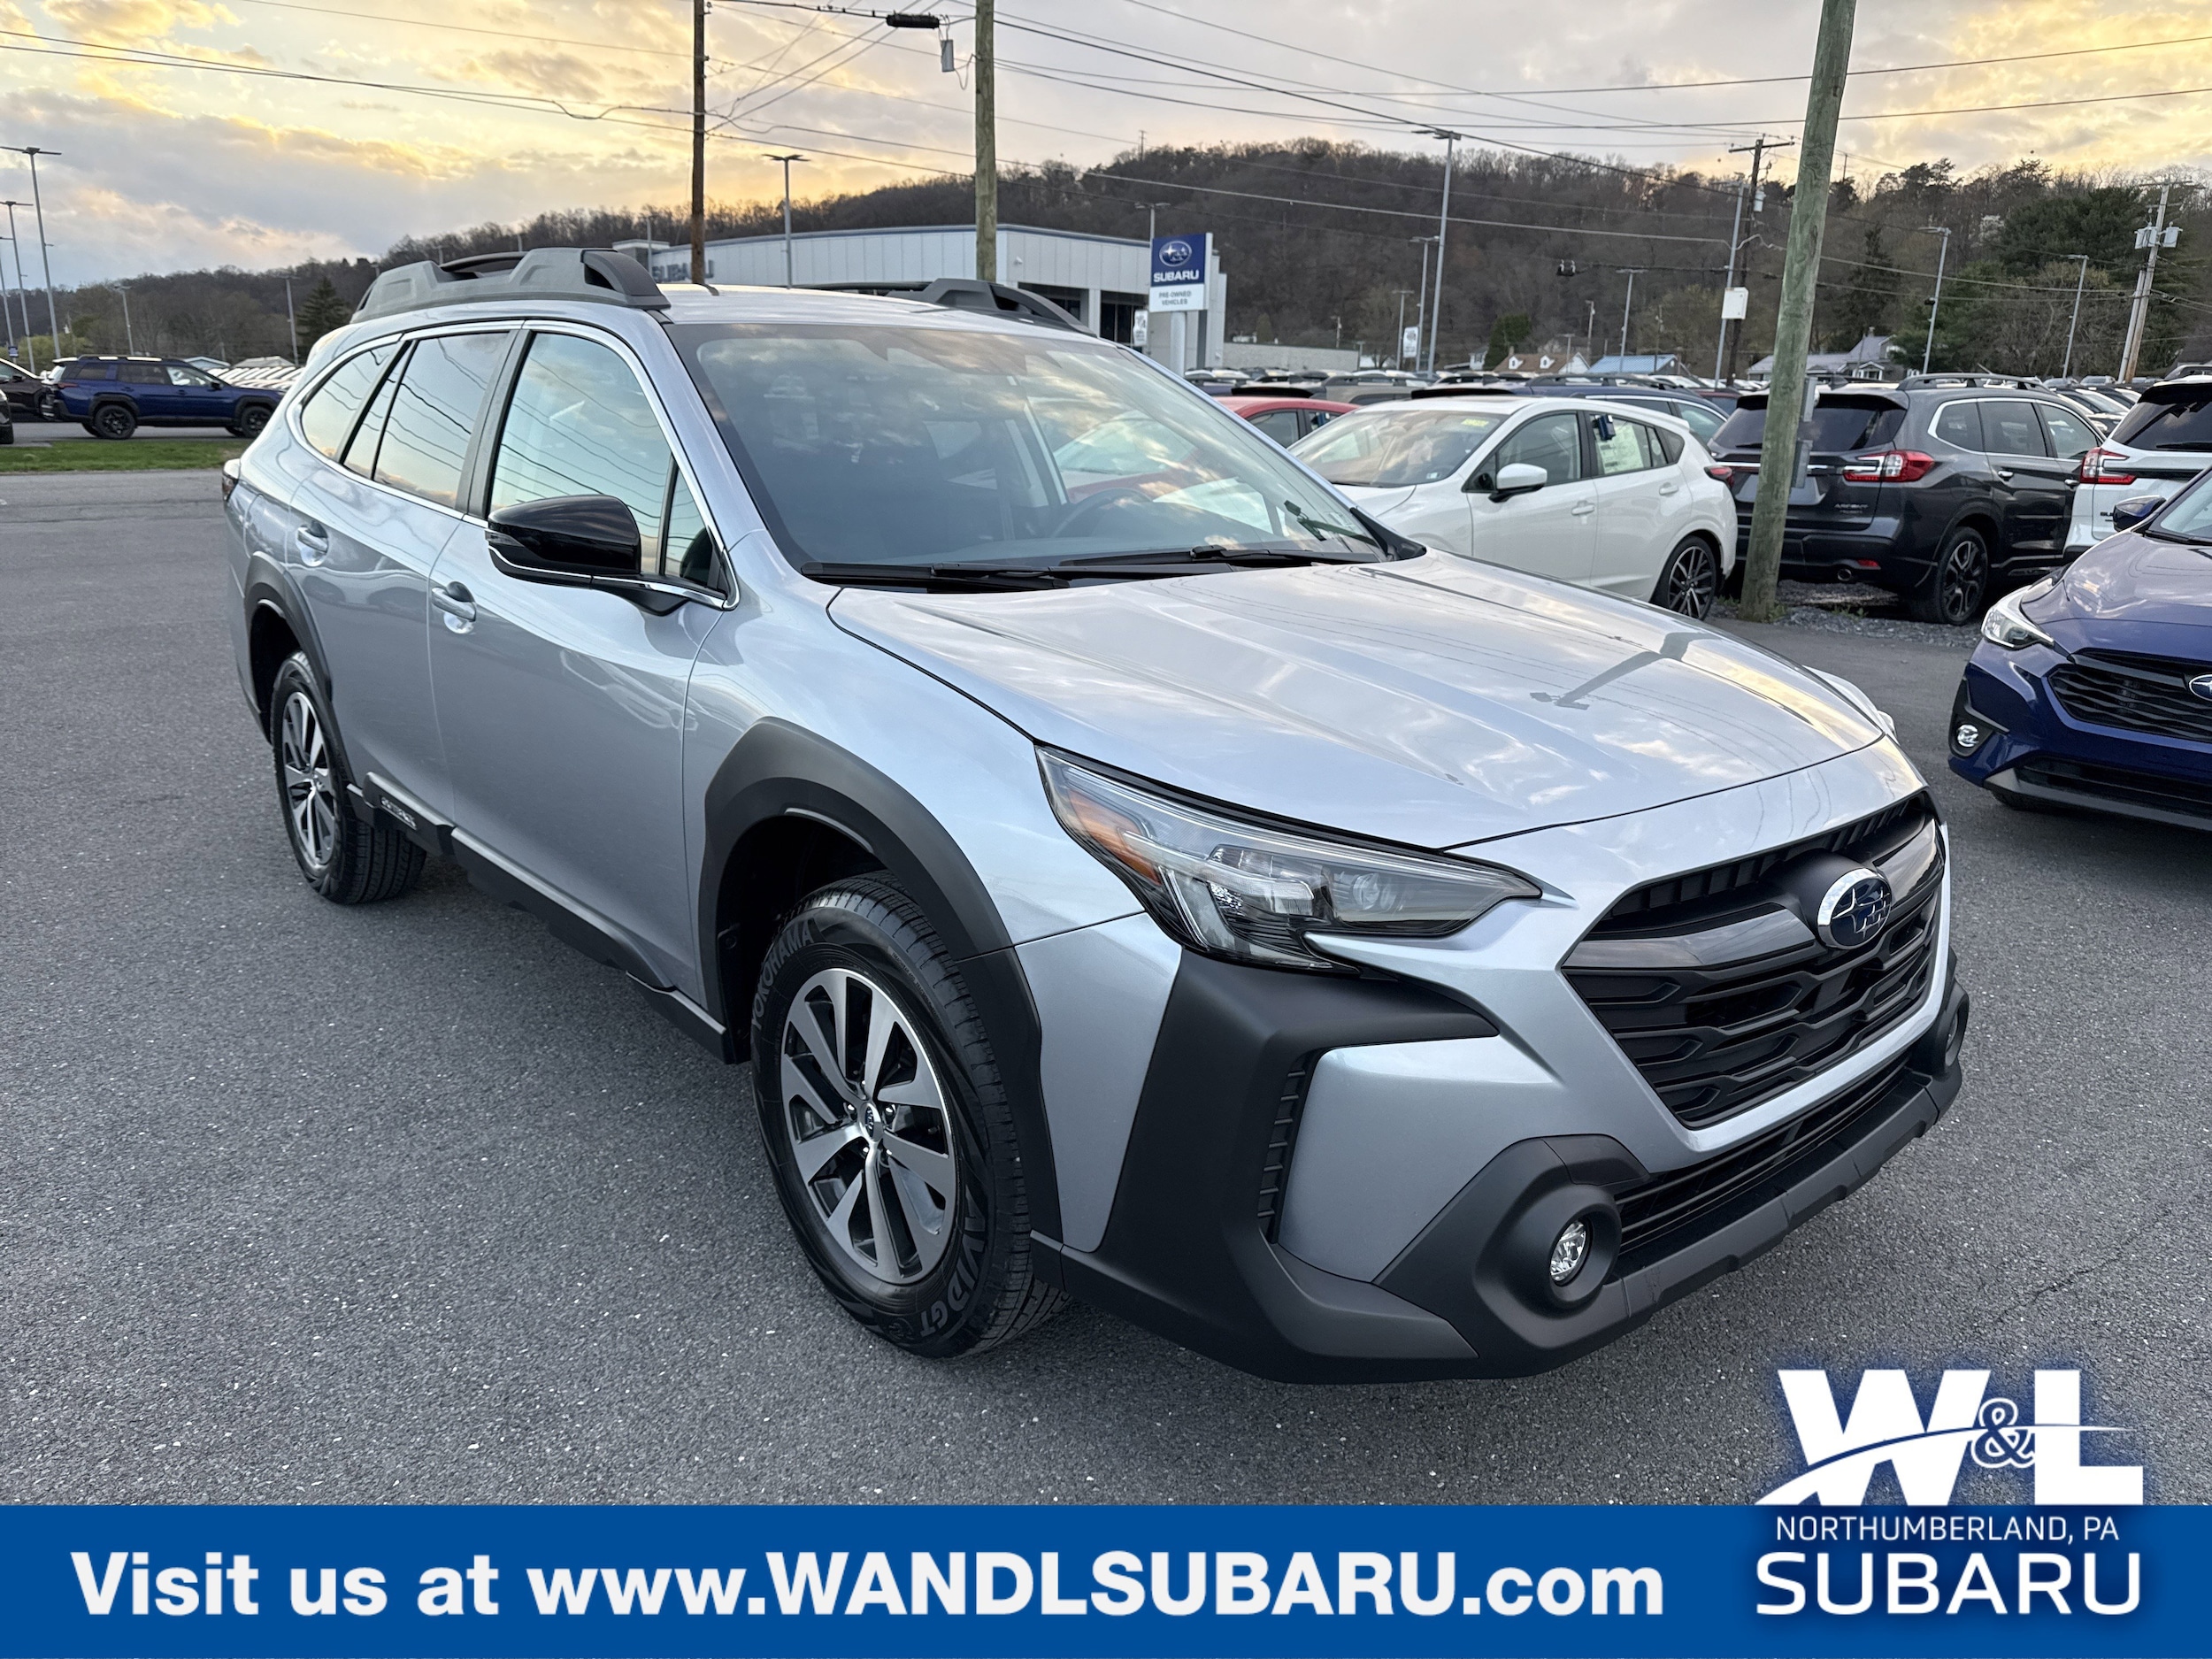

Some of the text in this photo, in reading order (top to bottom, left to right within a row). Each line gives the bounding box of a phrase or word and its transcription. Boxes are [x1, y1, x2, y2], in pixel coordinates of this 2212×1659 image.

[1153, 269, 1200, 283] SUBARU
[751, 919, 814, 1030] YOKOHAMA
[920, 1185, 986, 1337] AVID GT
